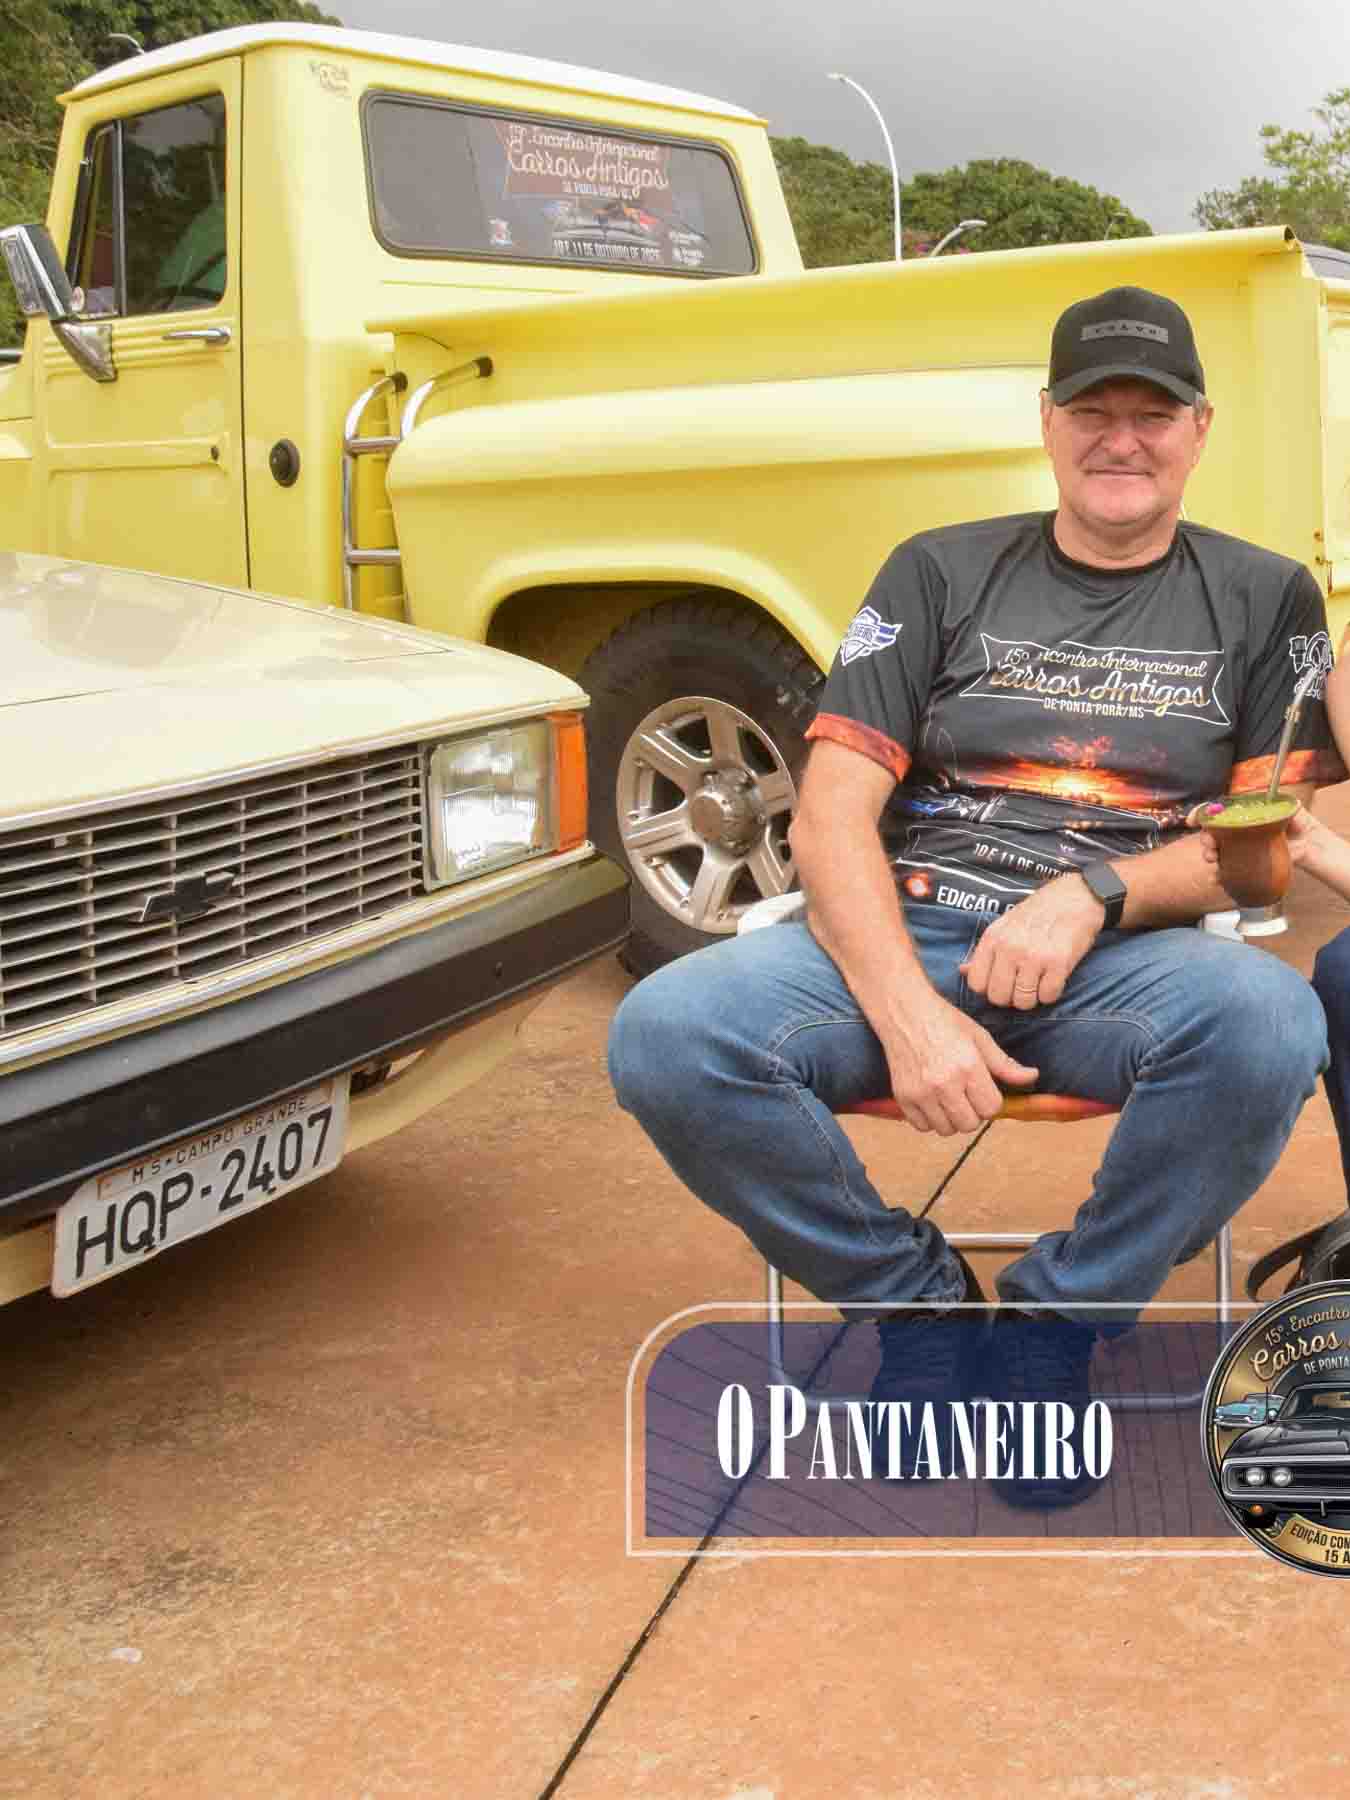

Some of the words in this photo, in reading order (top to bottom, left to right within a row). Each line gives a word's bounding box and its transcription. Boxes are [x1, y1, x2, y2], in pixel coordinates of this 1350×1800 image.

[509, 149, 583, 178] Carros
[585, 150, 668, 199] Antigos
[1100, 651, 1207, 677] Internacional
[1043, 697, 1057, 710] DE
[1059, 699, 1092, 713] PONTA
[1089, 671, 1211, 716] Antigos
[75, 1105, 333, 1279] HQP-2407
